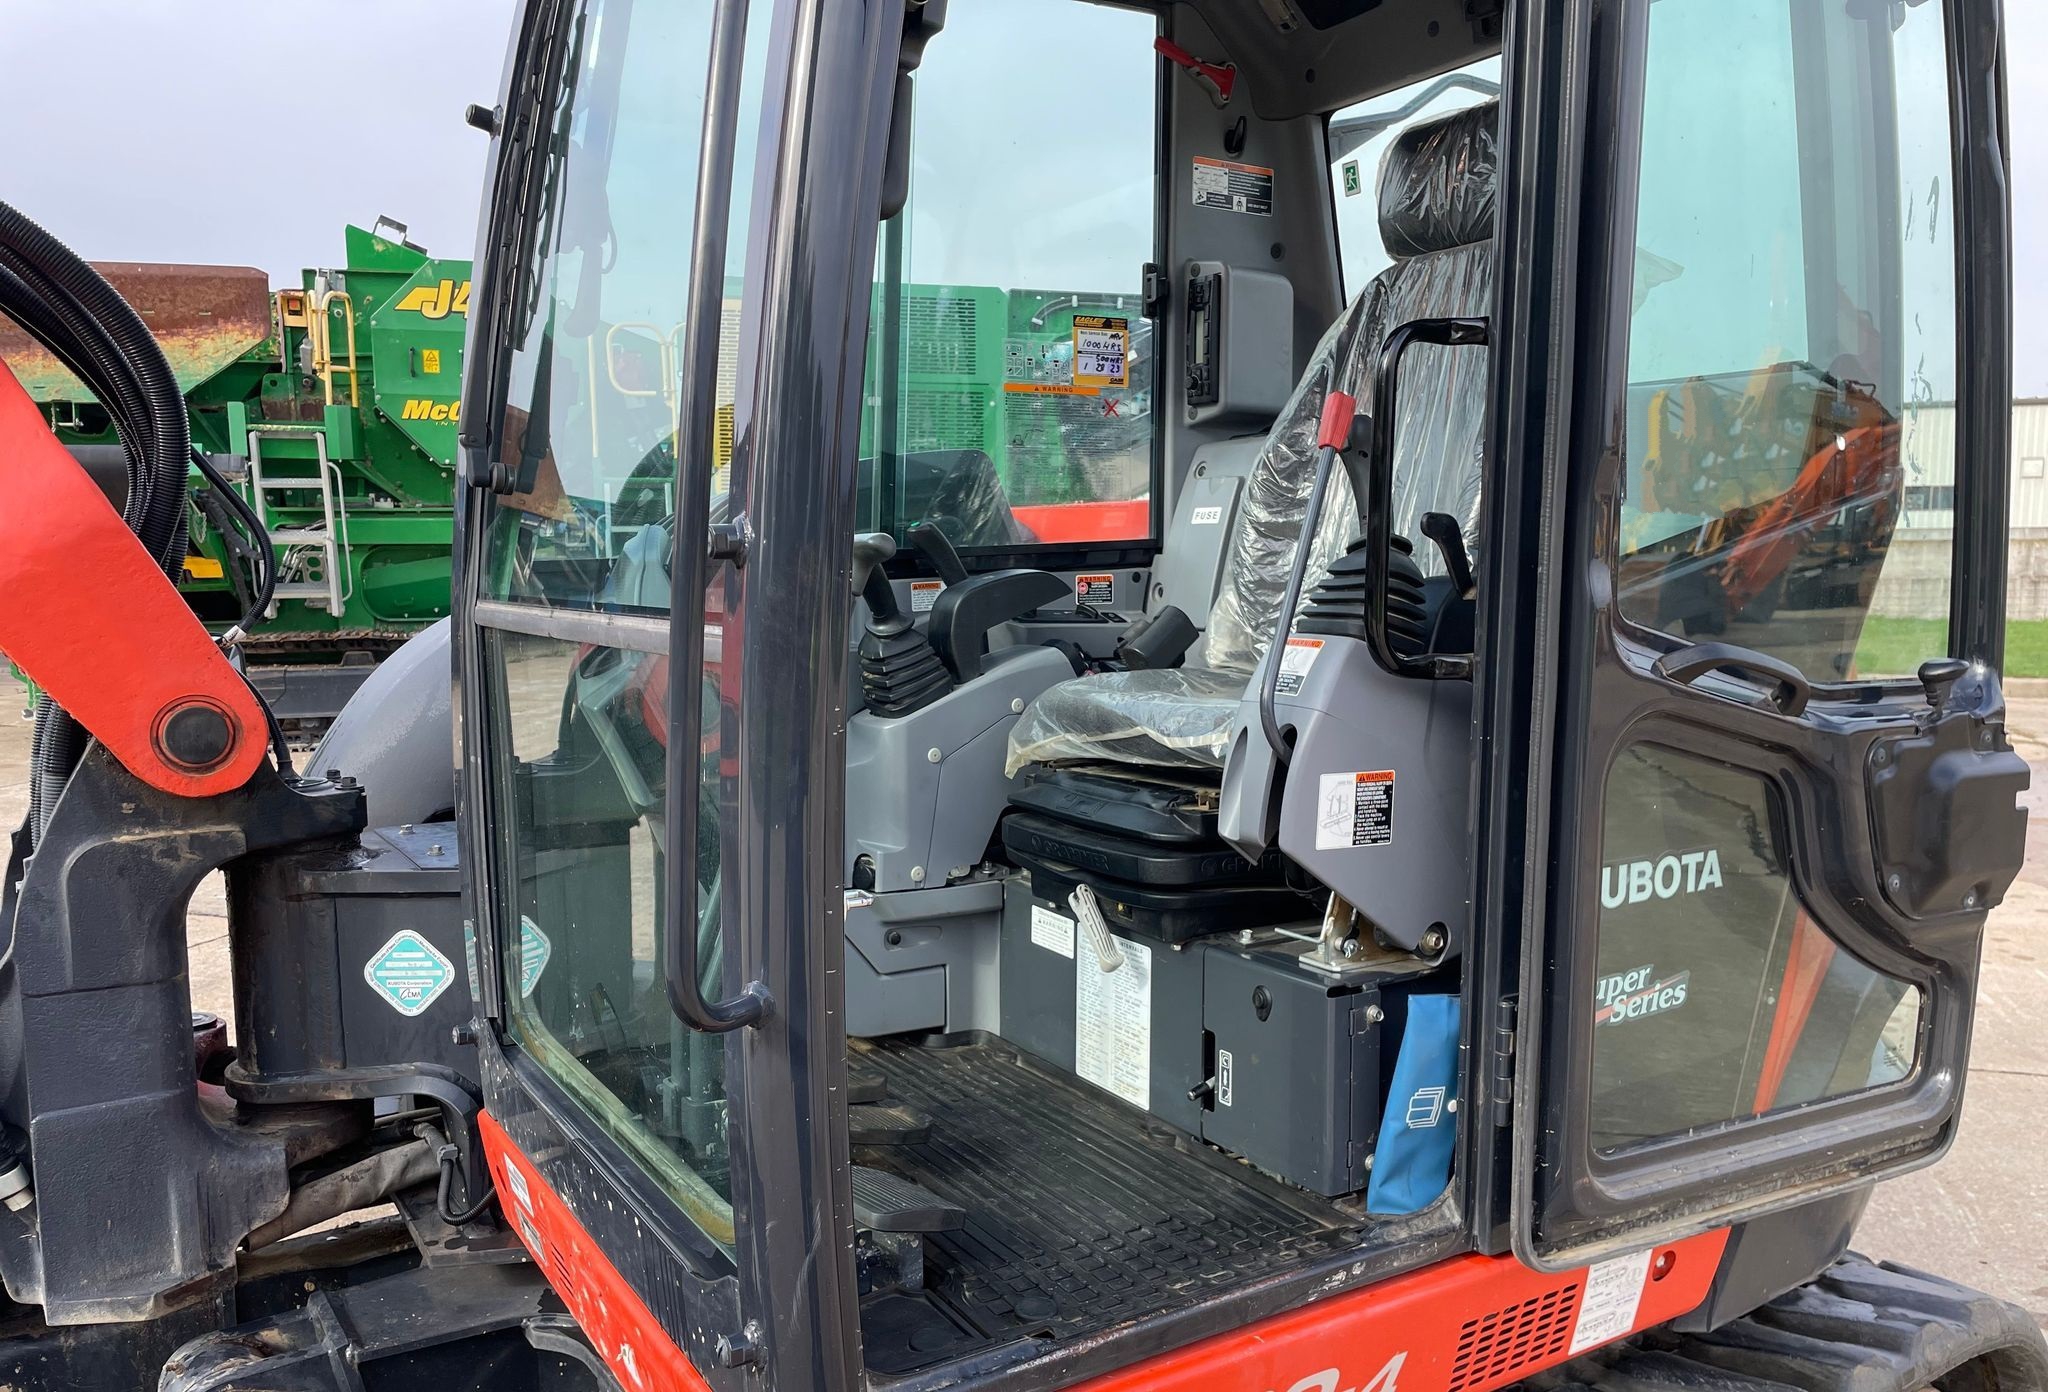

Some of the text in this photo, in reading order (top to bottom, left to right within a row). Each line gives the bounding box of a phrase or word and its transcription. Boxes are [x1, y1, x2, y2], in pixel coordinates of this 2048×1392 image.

[1195, 511, 1219, 520] FUSE
[1366, 772, 1392, 780] WARNING
[1610, 983, 1687, 1023] Series
